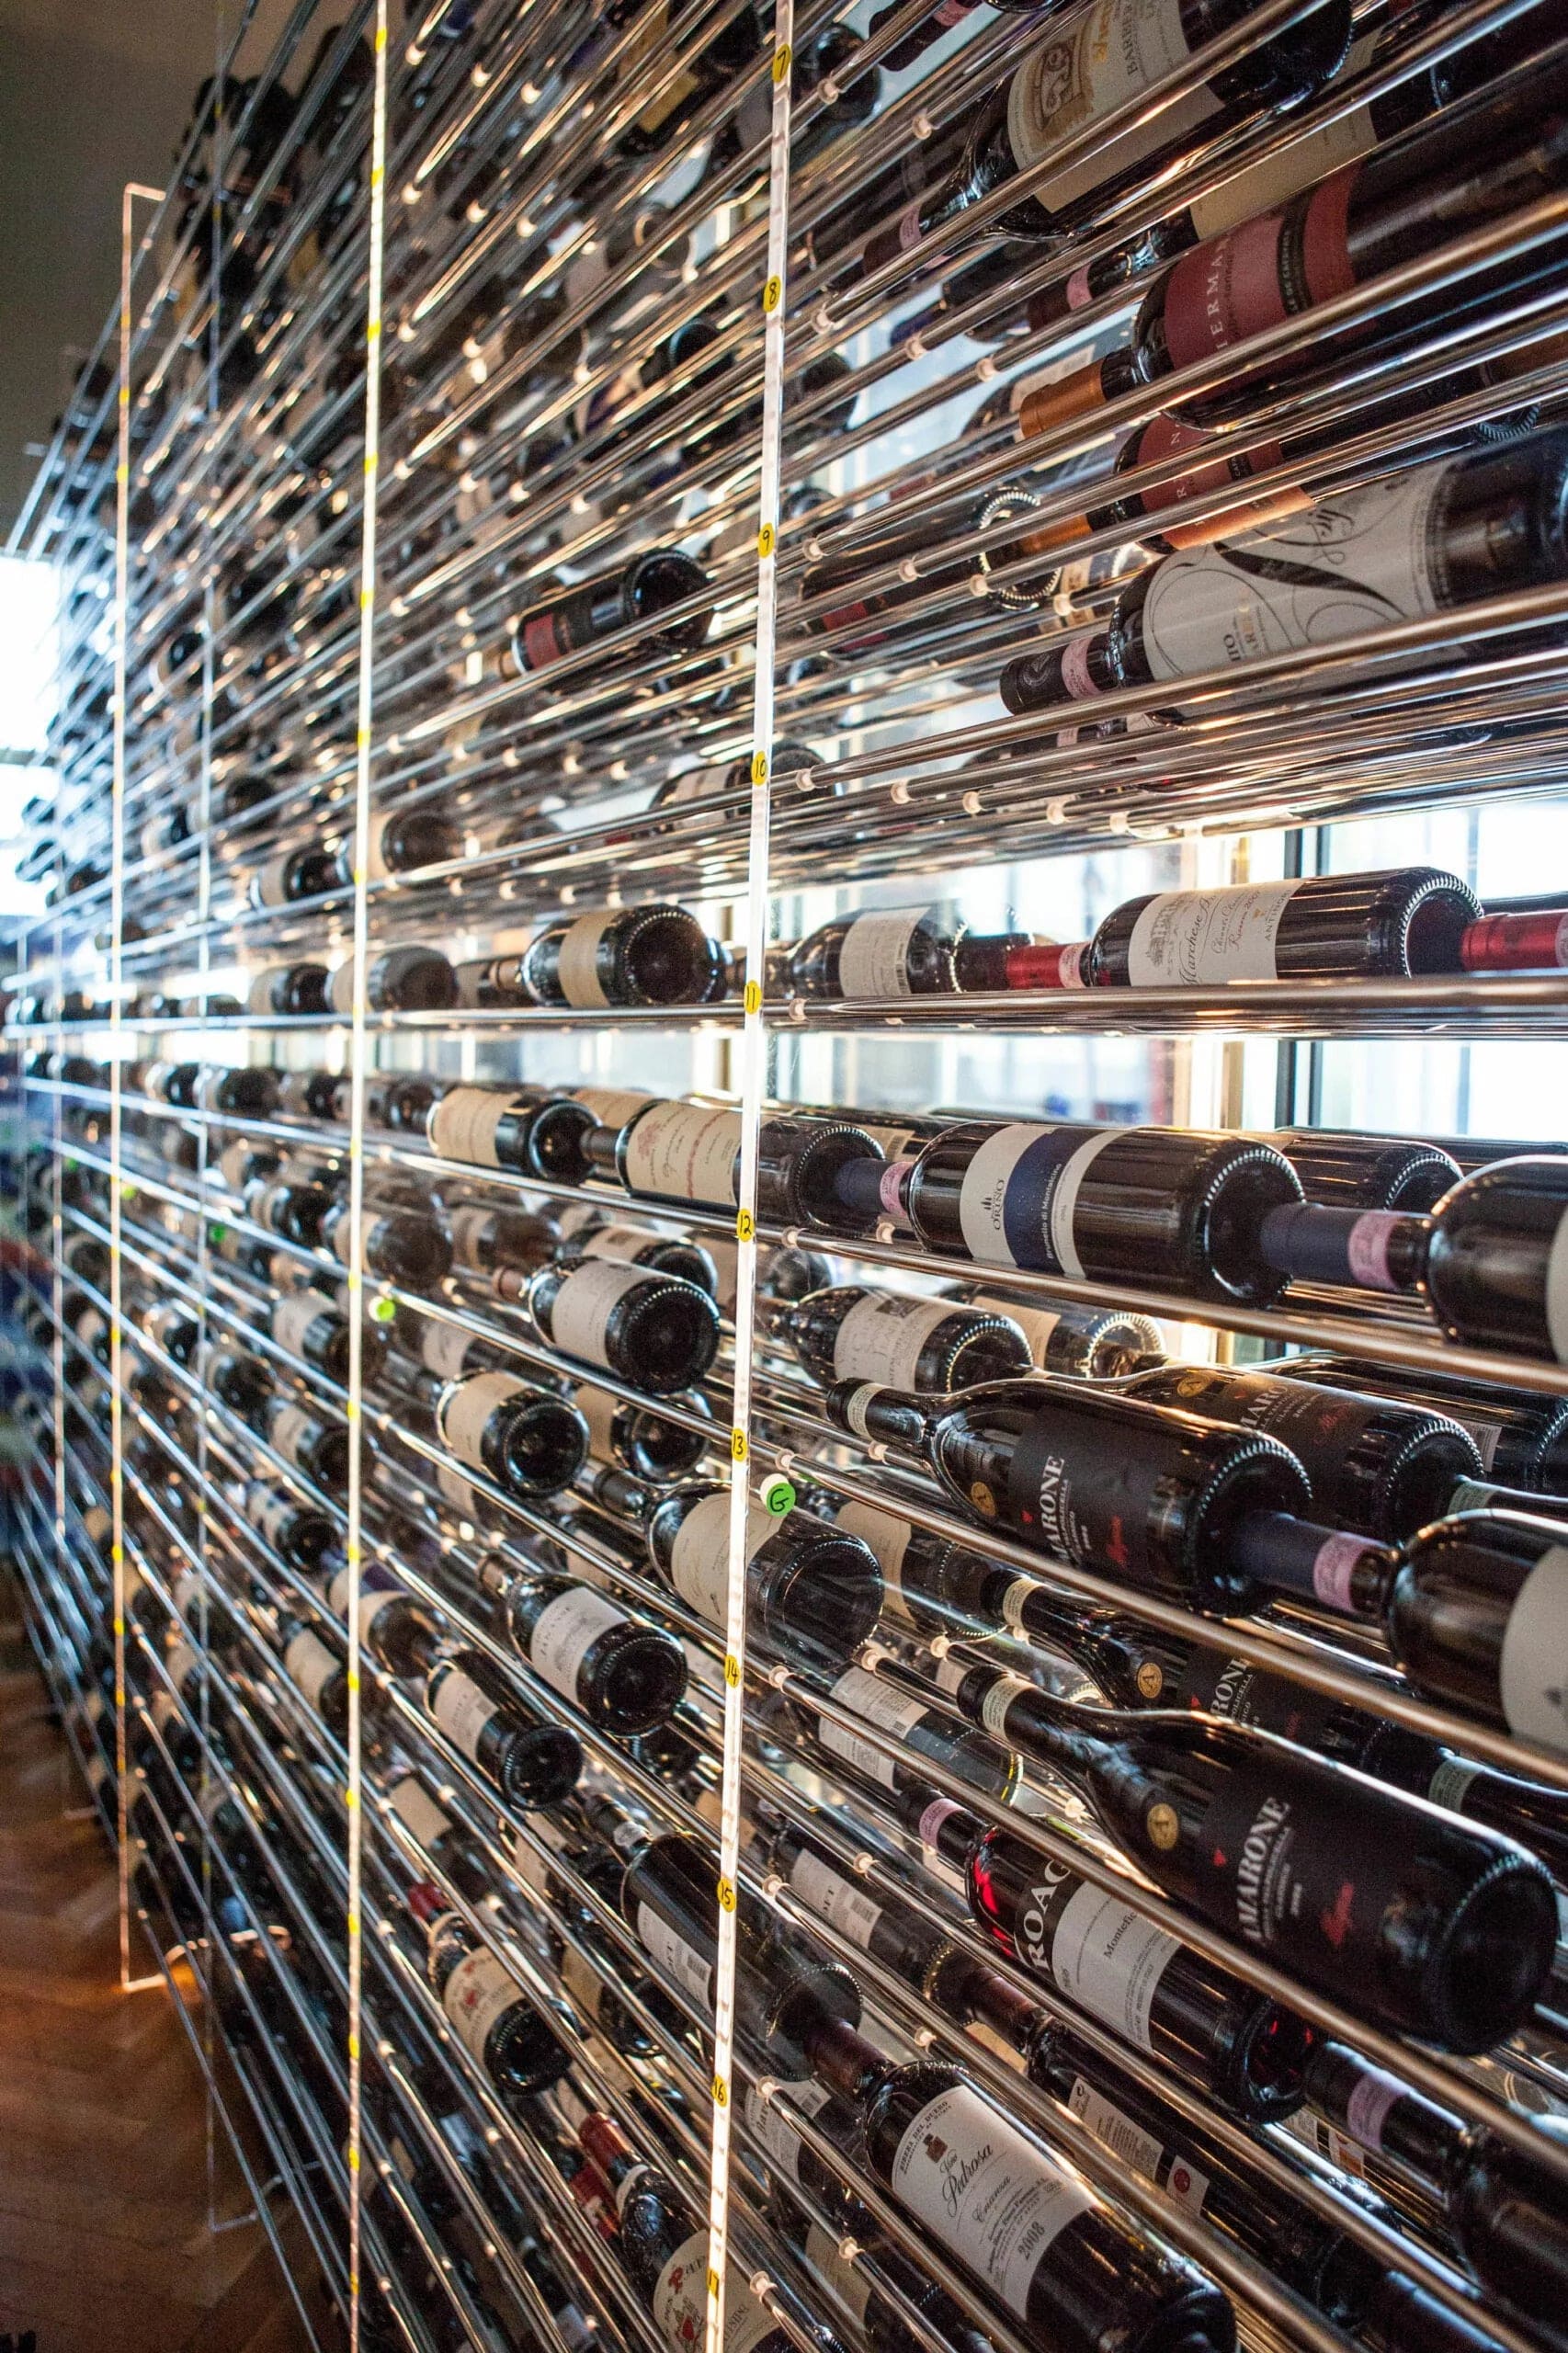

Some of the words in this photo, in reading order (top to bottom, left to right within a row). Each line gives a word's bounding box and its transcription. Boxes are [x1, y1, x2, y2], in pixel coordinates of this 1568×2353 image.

[1041, 1163, 1063, 1211] Montalcino
[739, 1214, 752, 1237] 12
[733, 1433, 744, 1456] 13
[769, 1487, 790, 1513] G
[727, 1658, 738, 1686] 14
[722, 1880, 733, 1905] 15
[714, 2078, 724, 2103] 16
[942, 2143, 994, 2218] Pedrosa
[971, 2176, 1011, 2222] Crianza
[1017, 2221, 1046, 2261] 2008
